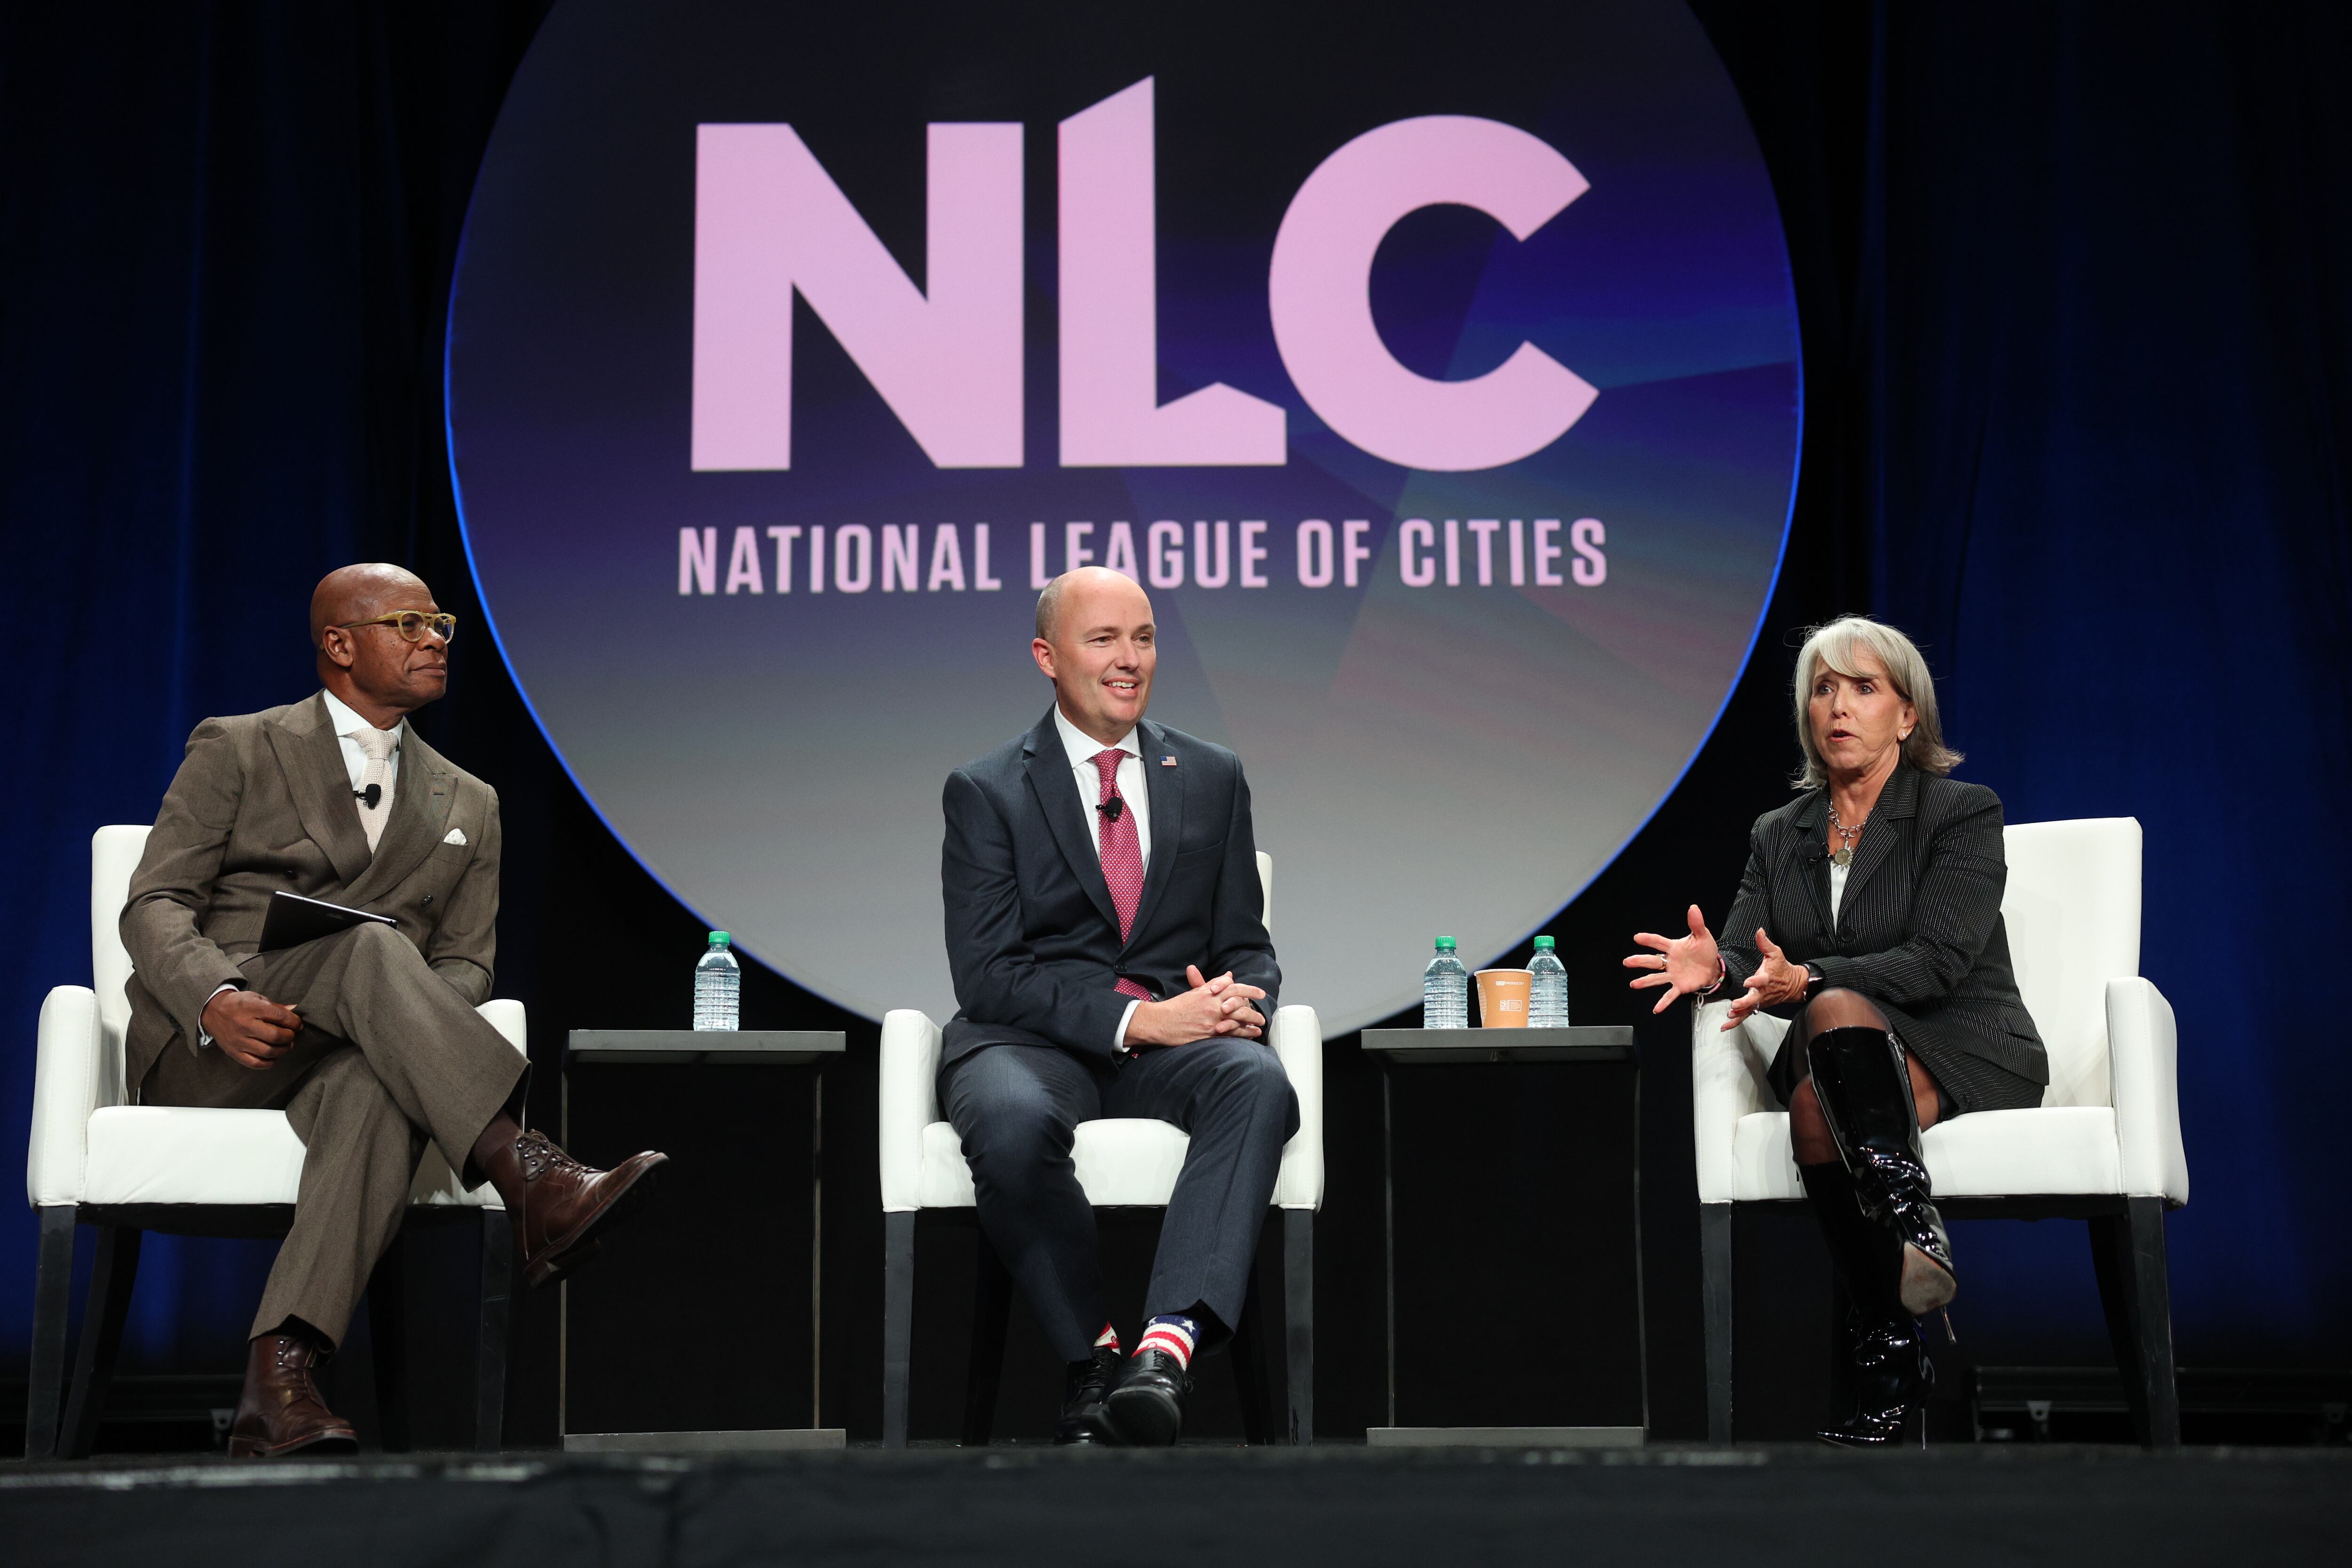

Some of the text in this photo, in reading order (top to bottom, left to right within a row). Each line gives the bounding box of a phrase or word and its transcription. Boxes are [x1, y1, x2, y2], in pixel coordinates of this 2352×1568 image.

[691, 75, 1600, 472] NLC
[678, 518, 1606, 596] NATIONAL LEAGUE OF CITIES
